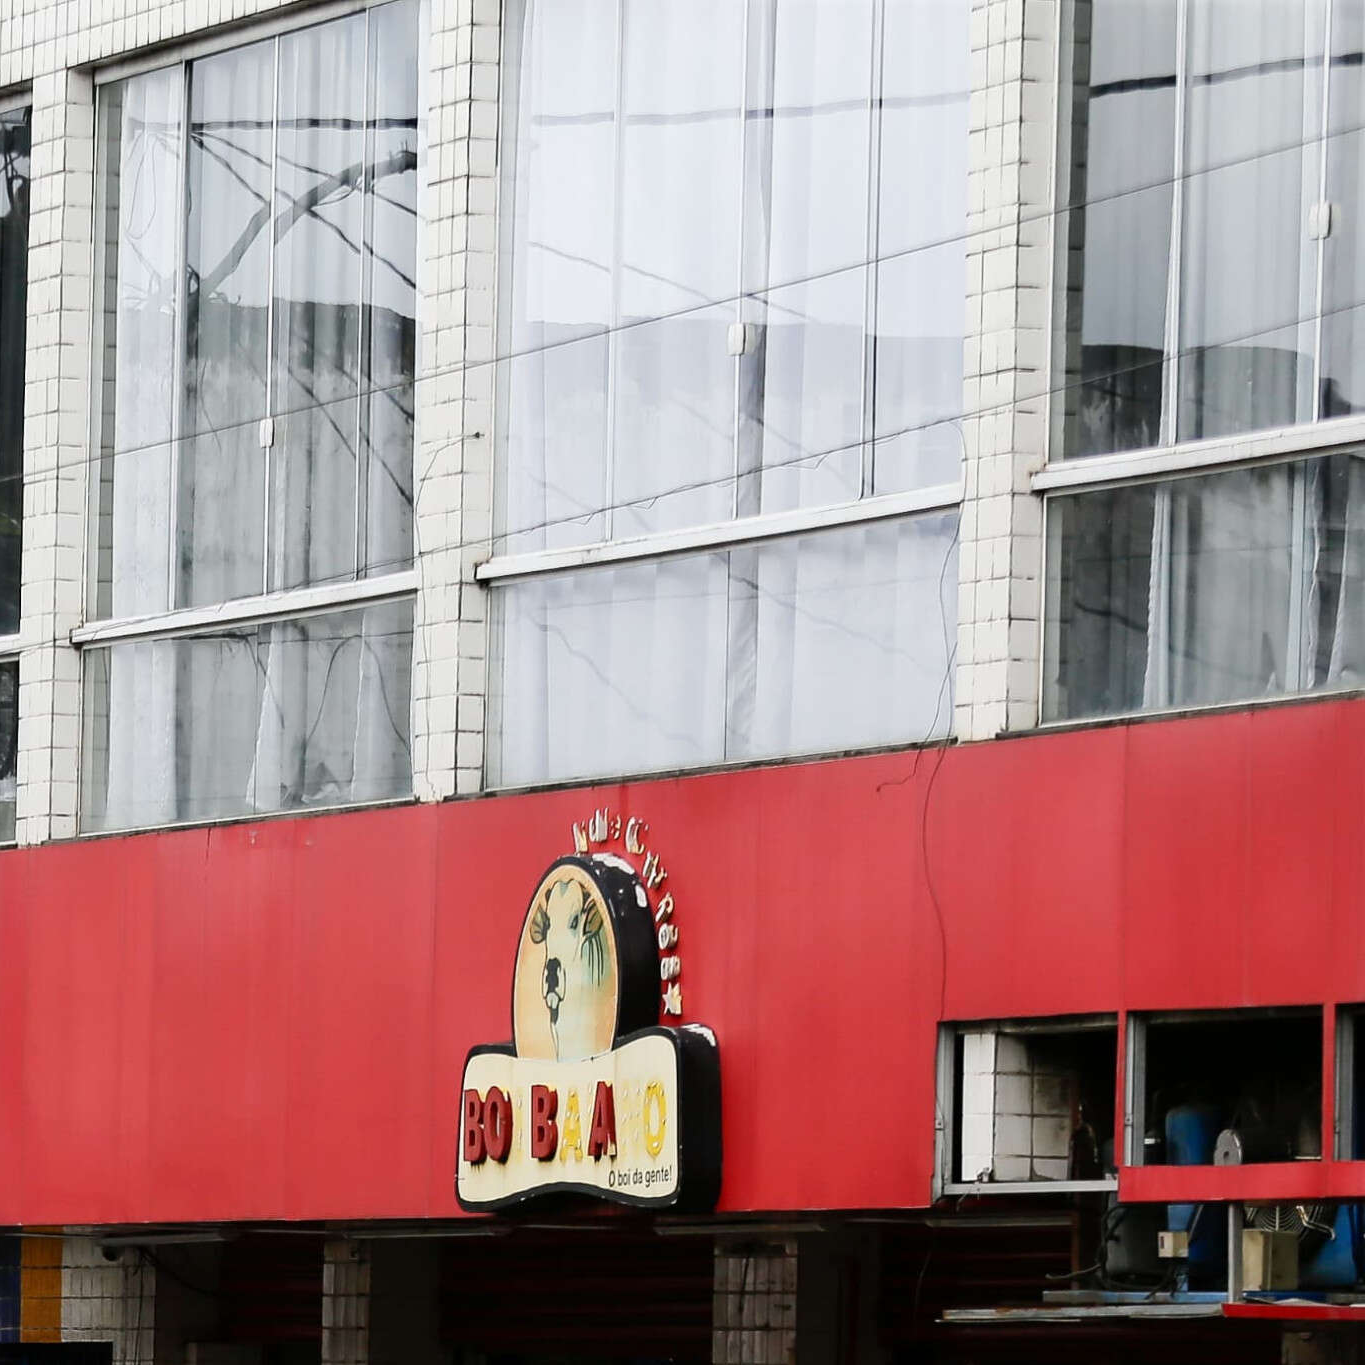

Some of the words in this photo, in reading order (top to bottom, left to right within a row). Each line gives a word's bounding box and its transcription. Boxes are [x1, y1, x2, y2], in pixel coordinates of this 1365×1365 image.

[609, 1170, 616, 1187] O
[618, 1169, 631, 1186] boi
[632, 1168, 643, 1184] da
[644, 1165, 673, 1187] gente!
